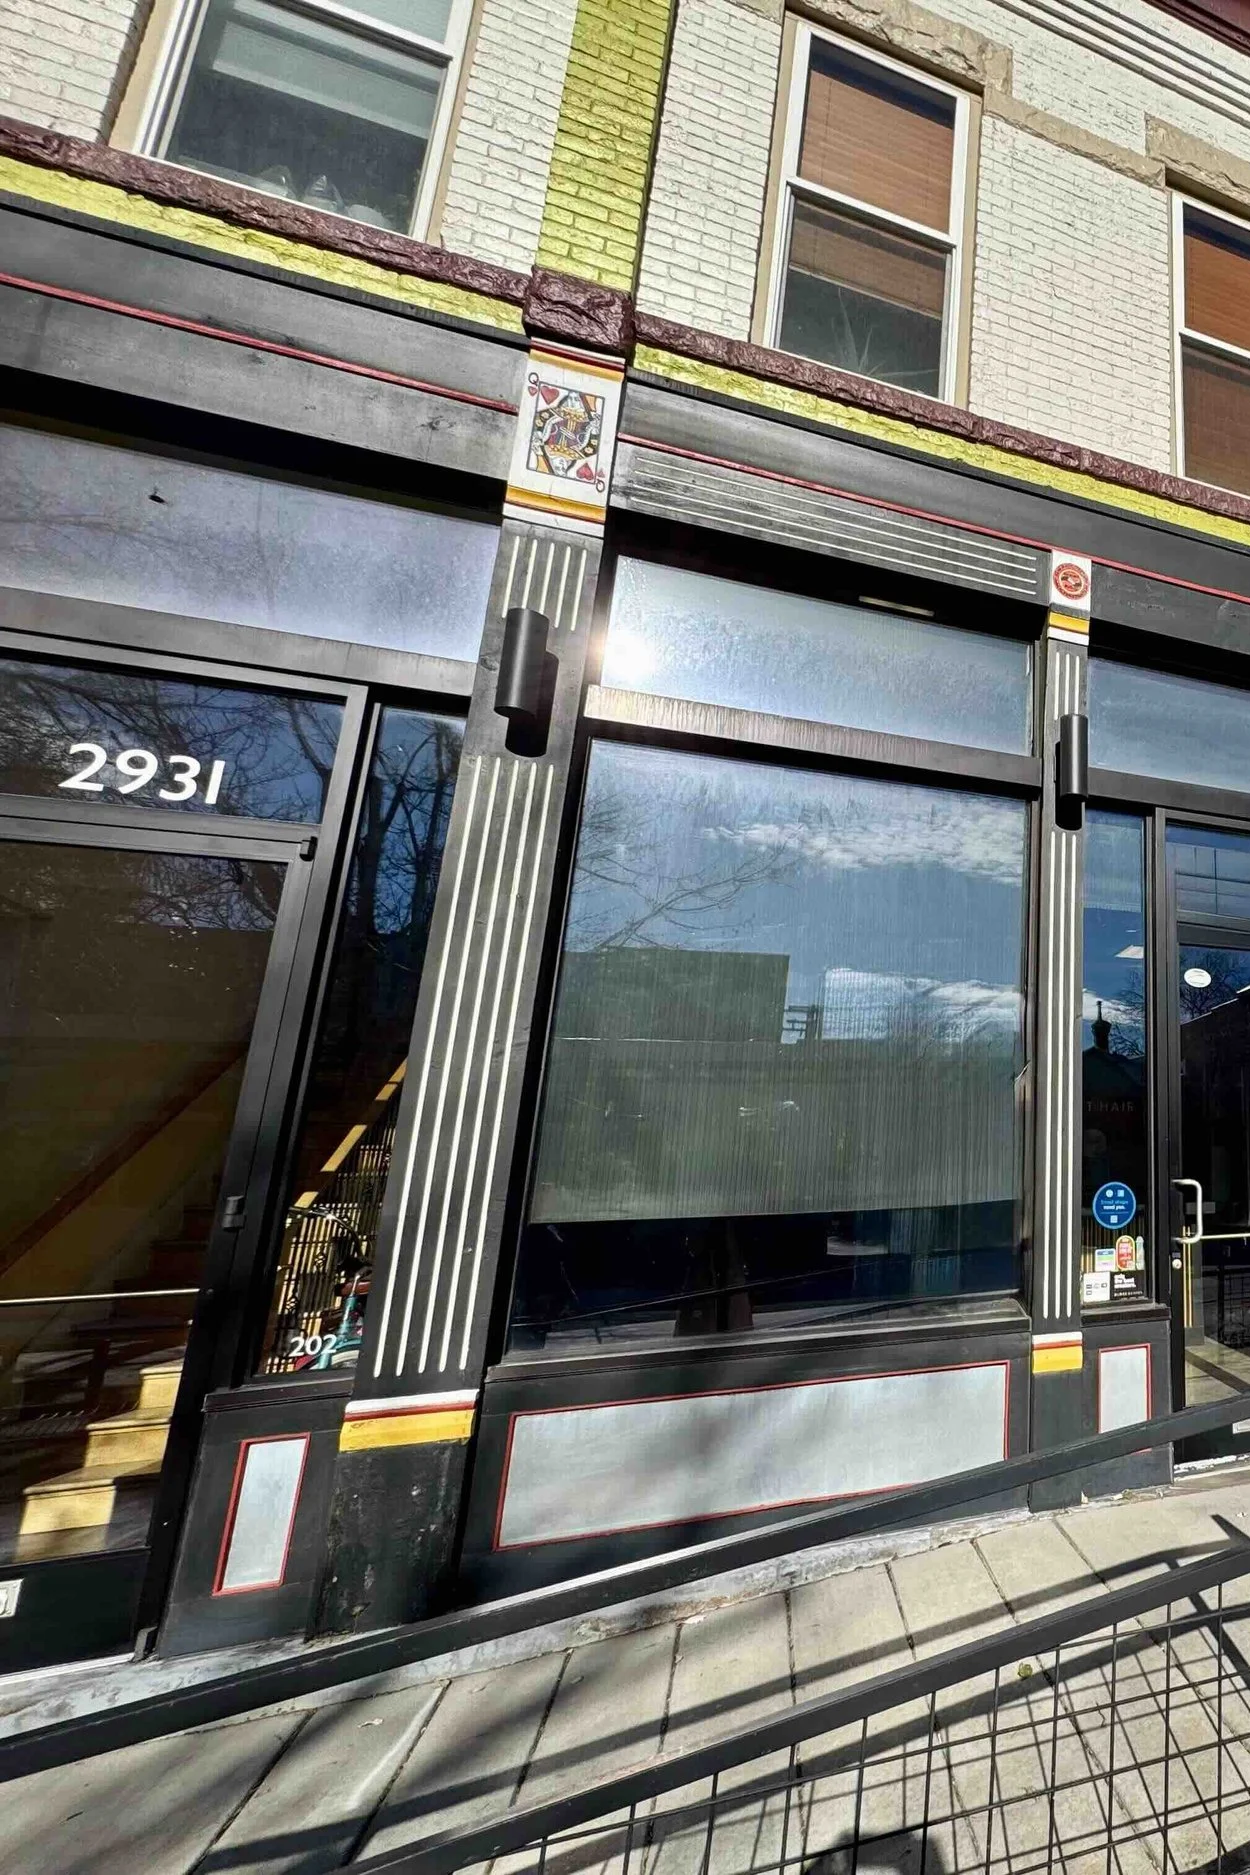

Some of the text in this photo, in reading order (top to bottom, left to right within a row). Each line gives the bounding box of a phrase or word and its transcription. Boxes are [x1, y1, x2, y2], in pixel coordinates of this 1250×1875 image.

[528, 372, 540, 386] Q
[595, 479, 606, 493] Q
[58, 743, 226, 805] 2931
[1099, 1100, 1137, 1113] HAIR
[289, 1334, 337, 1357] 202
